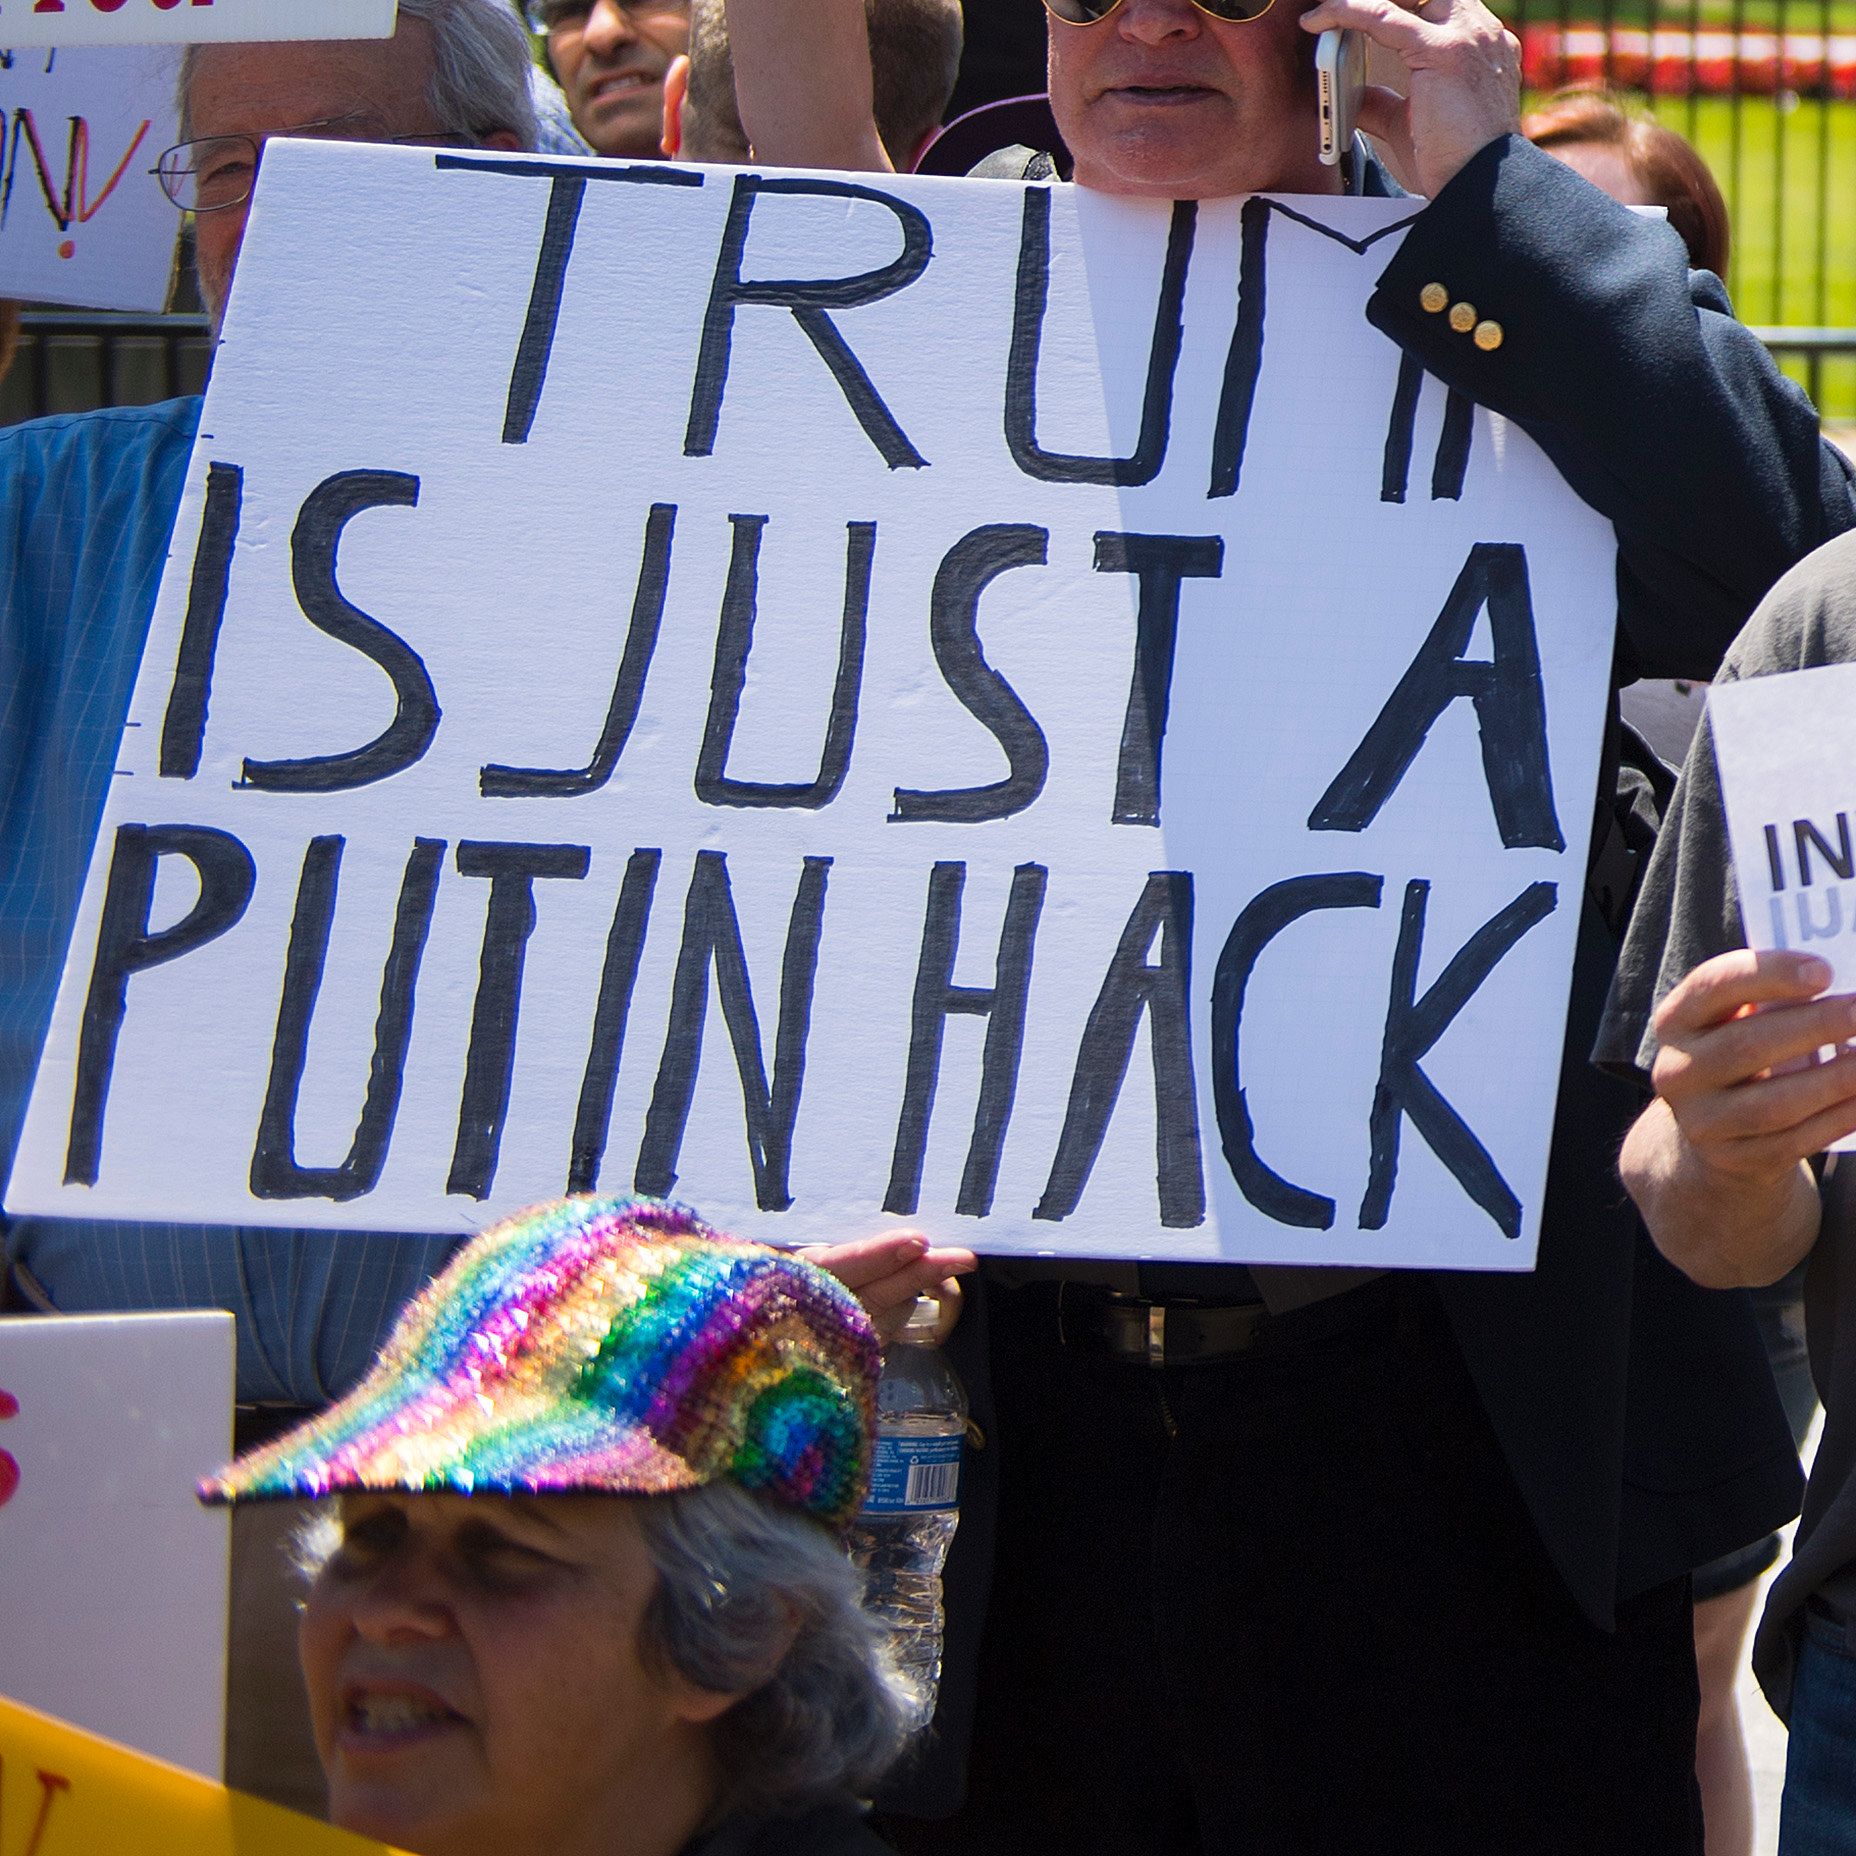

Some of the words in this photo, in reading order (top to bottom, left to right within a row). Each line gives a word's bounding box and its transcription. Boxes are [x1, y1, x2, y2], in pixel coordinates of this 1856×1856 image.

[435, 153, 1477, 505] TRUM
[158, 462, 442, 795] IS
[477, 501, 1225, 829] JUST
[1307, 540, 1568, 854] A
[63, 822, 835, 1213] PUTIN
[882, 859, 1560, 1241] HACK
